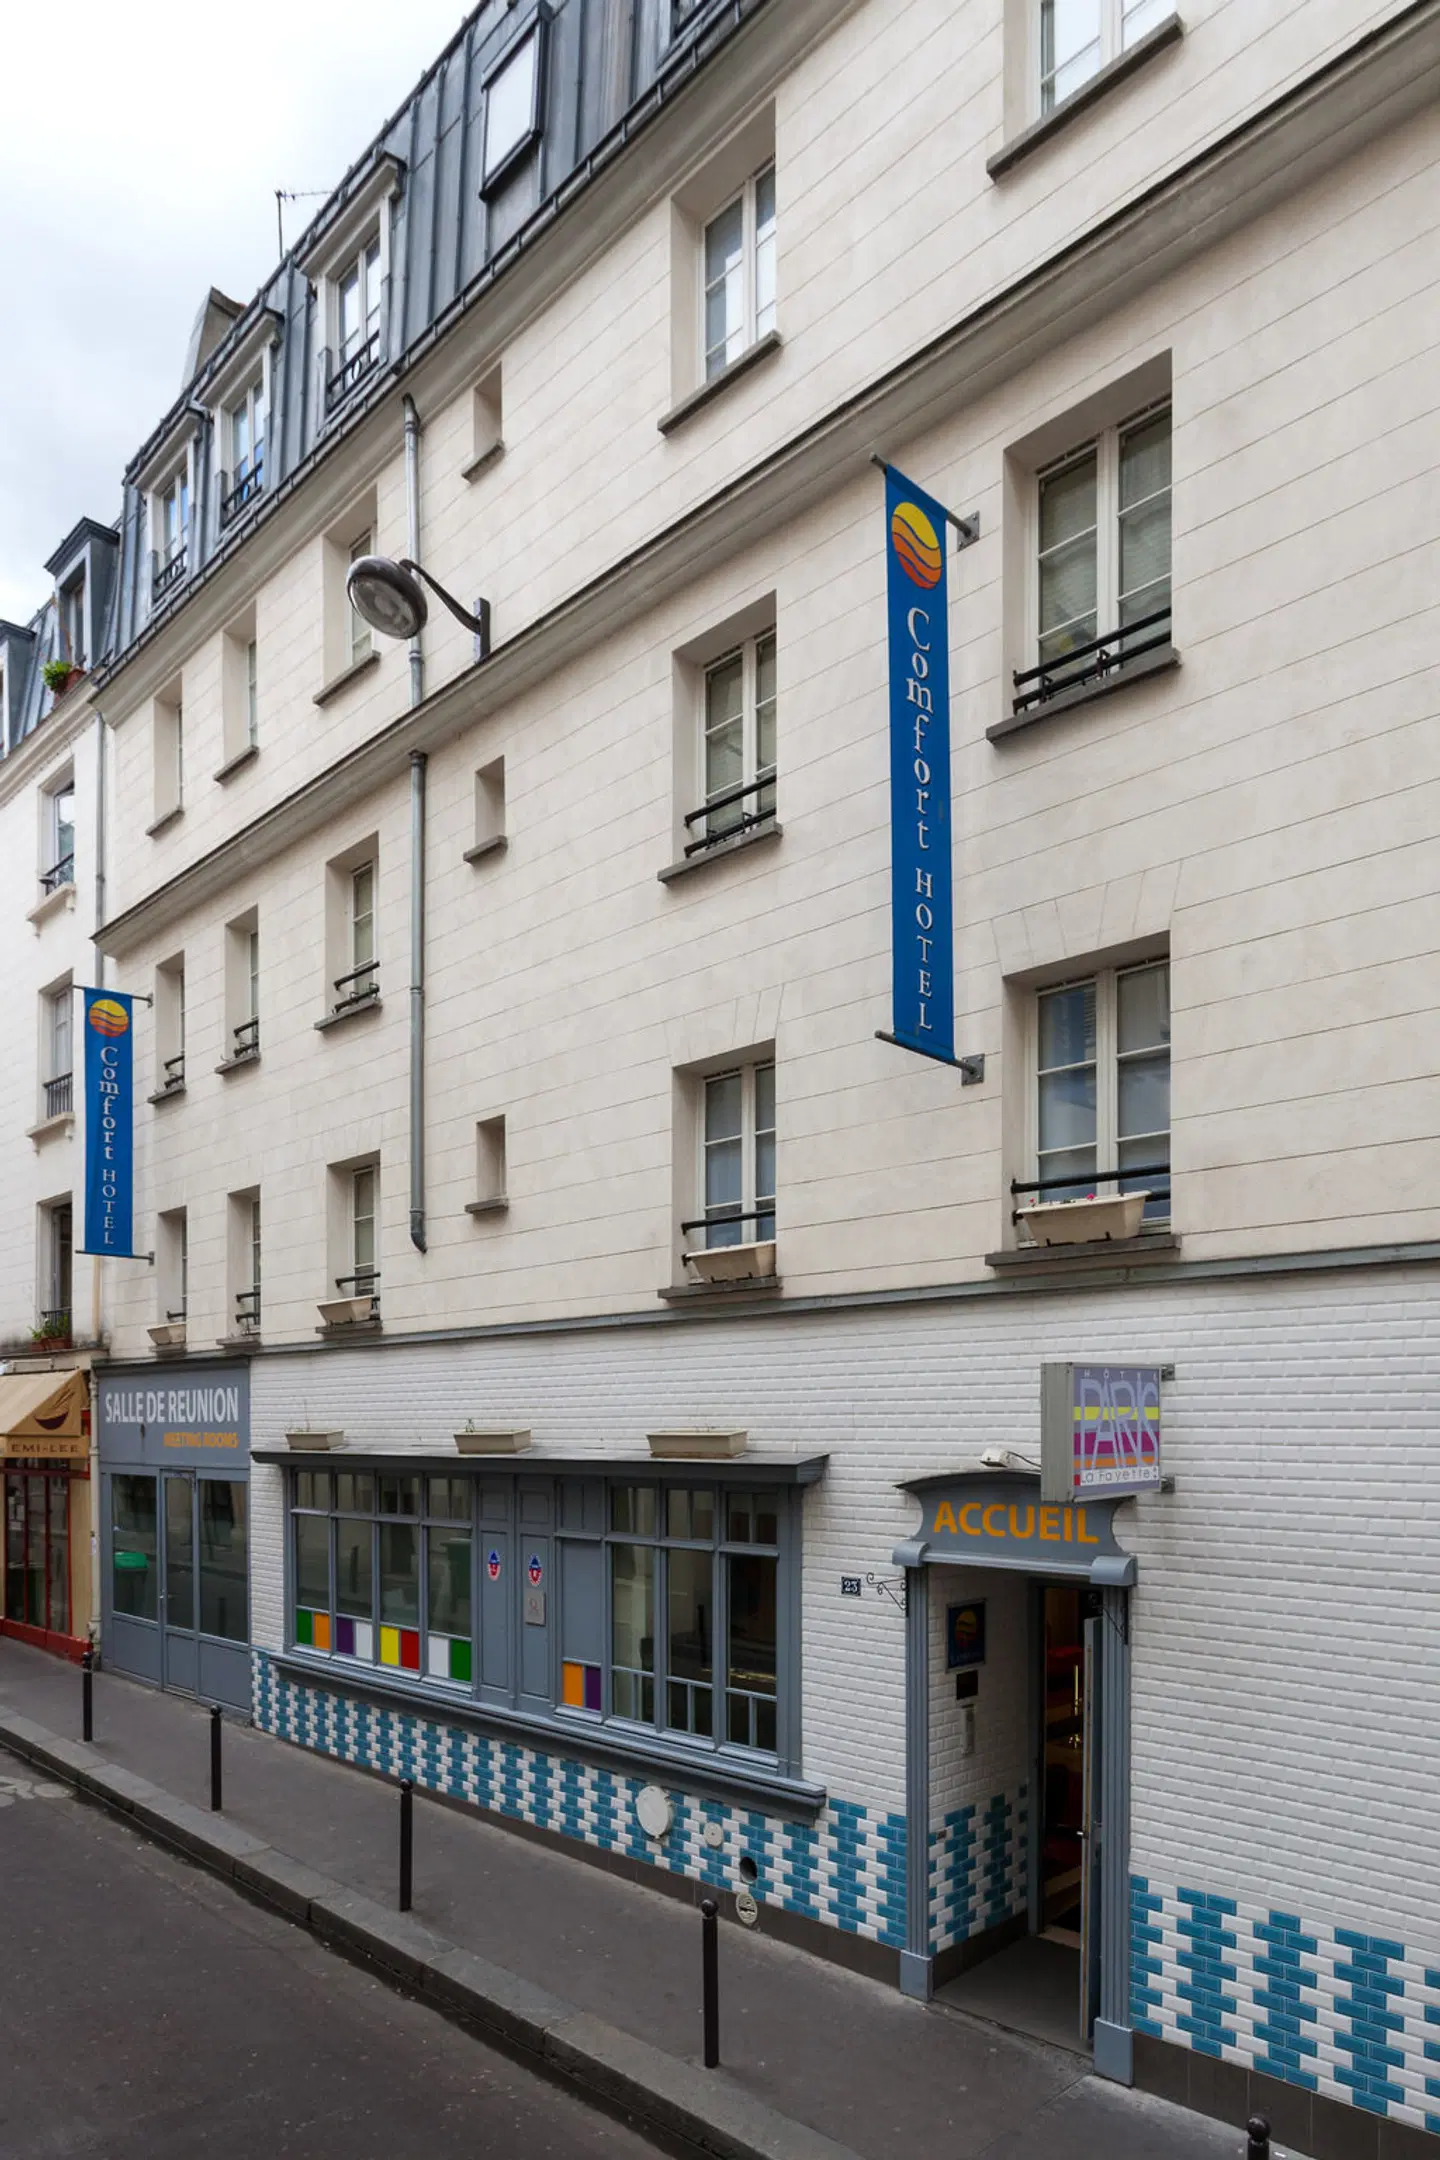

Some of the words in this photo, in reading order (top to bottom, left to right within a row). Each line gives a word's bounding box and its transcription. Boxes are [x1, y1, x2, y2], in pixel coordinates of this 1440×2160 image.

[906, 607, 934, 849] Comfort
[915, 867, 933, 1030] HOTEL
[99, 1046, 120, 1160] Comfort
[102, 1168, 117, 1245] HOTEL
[105, 1391, 144, 1423] SALLE
[146, 1391, 165, 1423] DE
[168, 1386, 239, 1422] REUNION
[1080, 1379, 1159, 1470] PARIS
[11, 1443, 80, 1453] EMI-LEE
[933, 1501, 1099, 1544] ACCUEIL
[844, 1580, 858, 1593] 23
